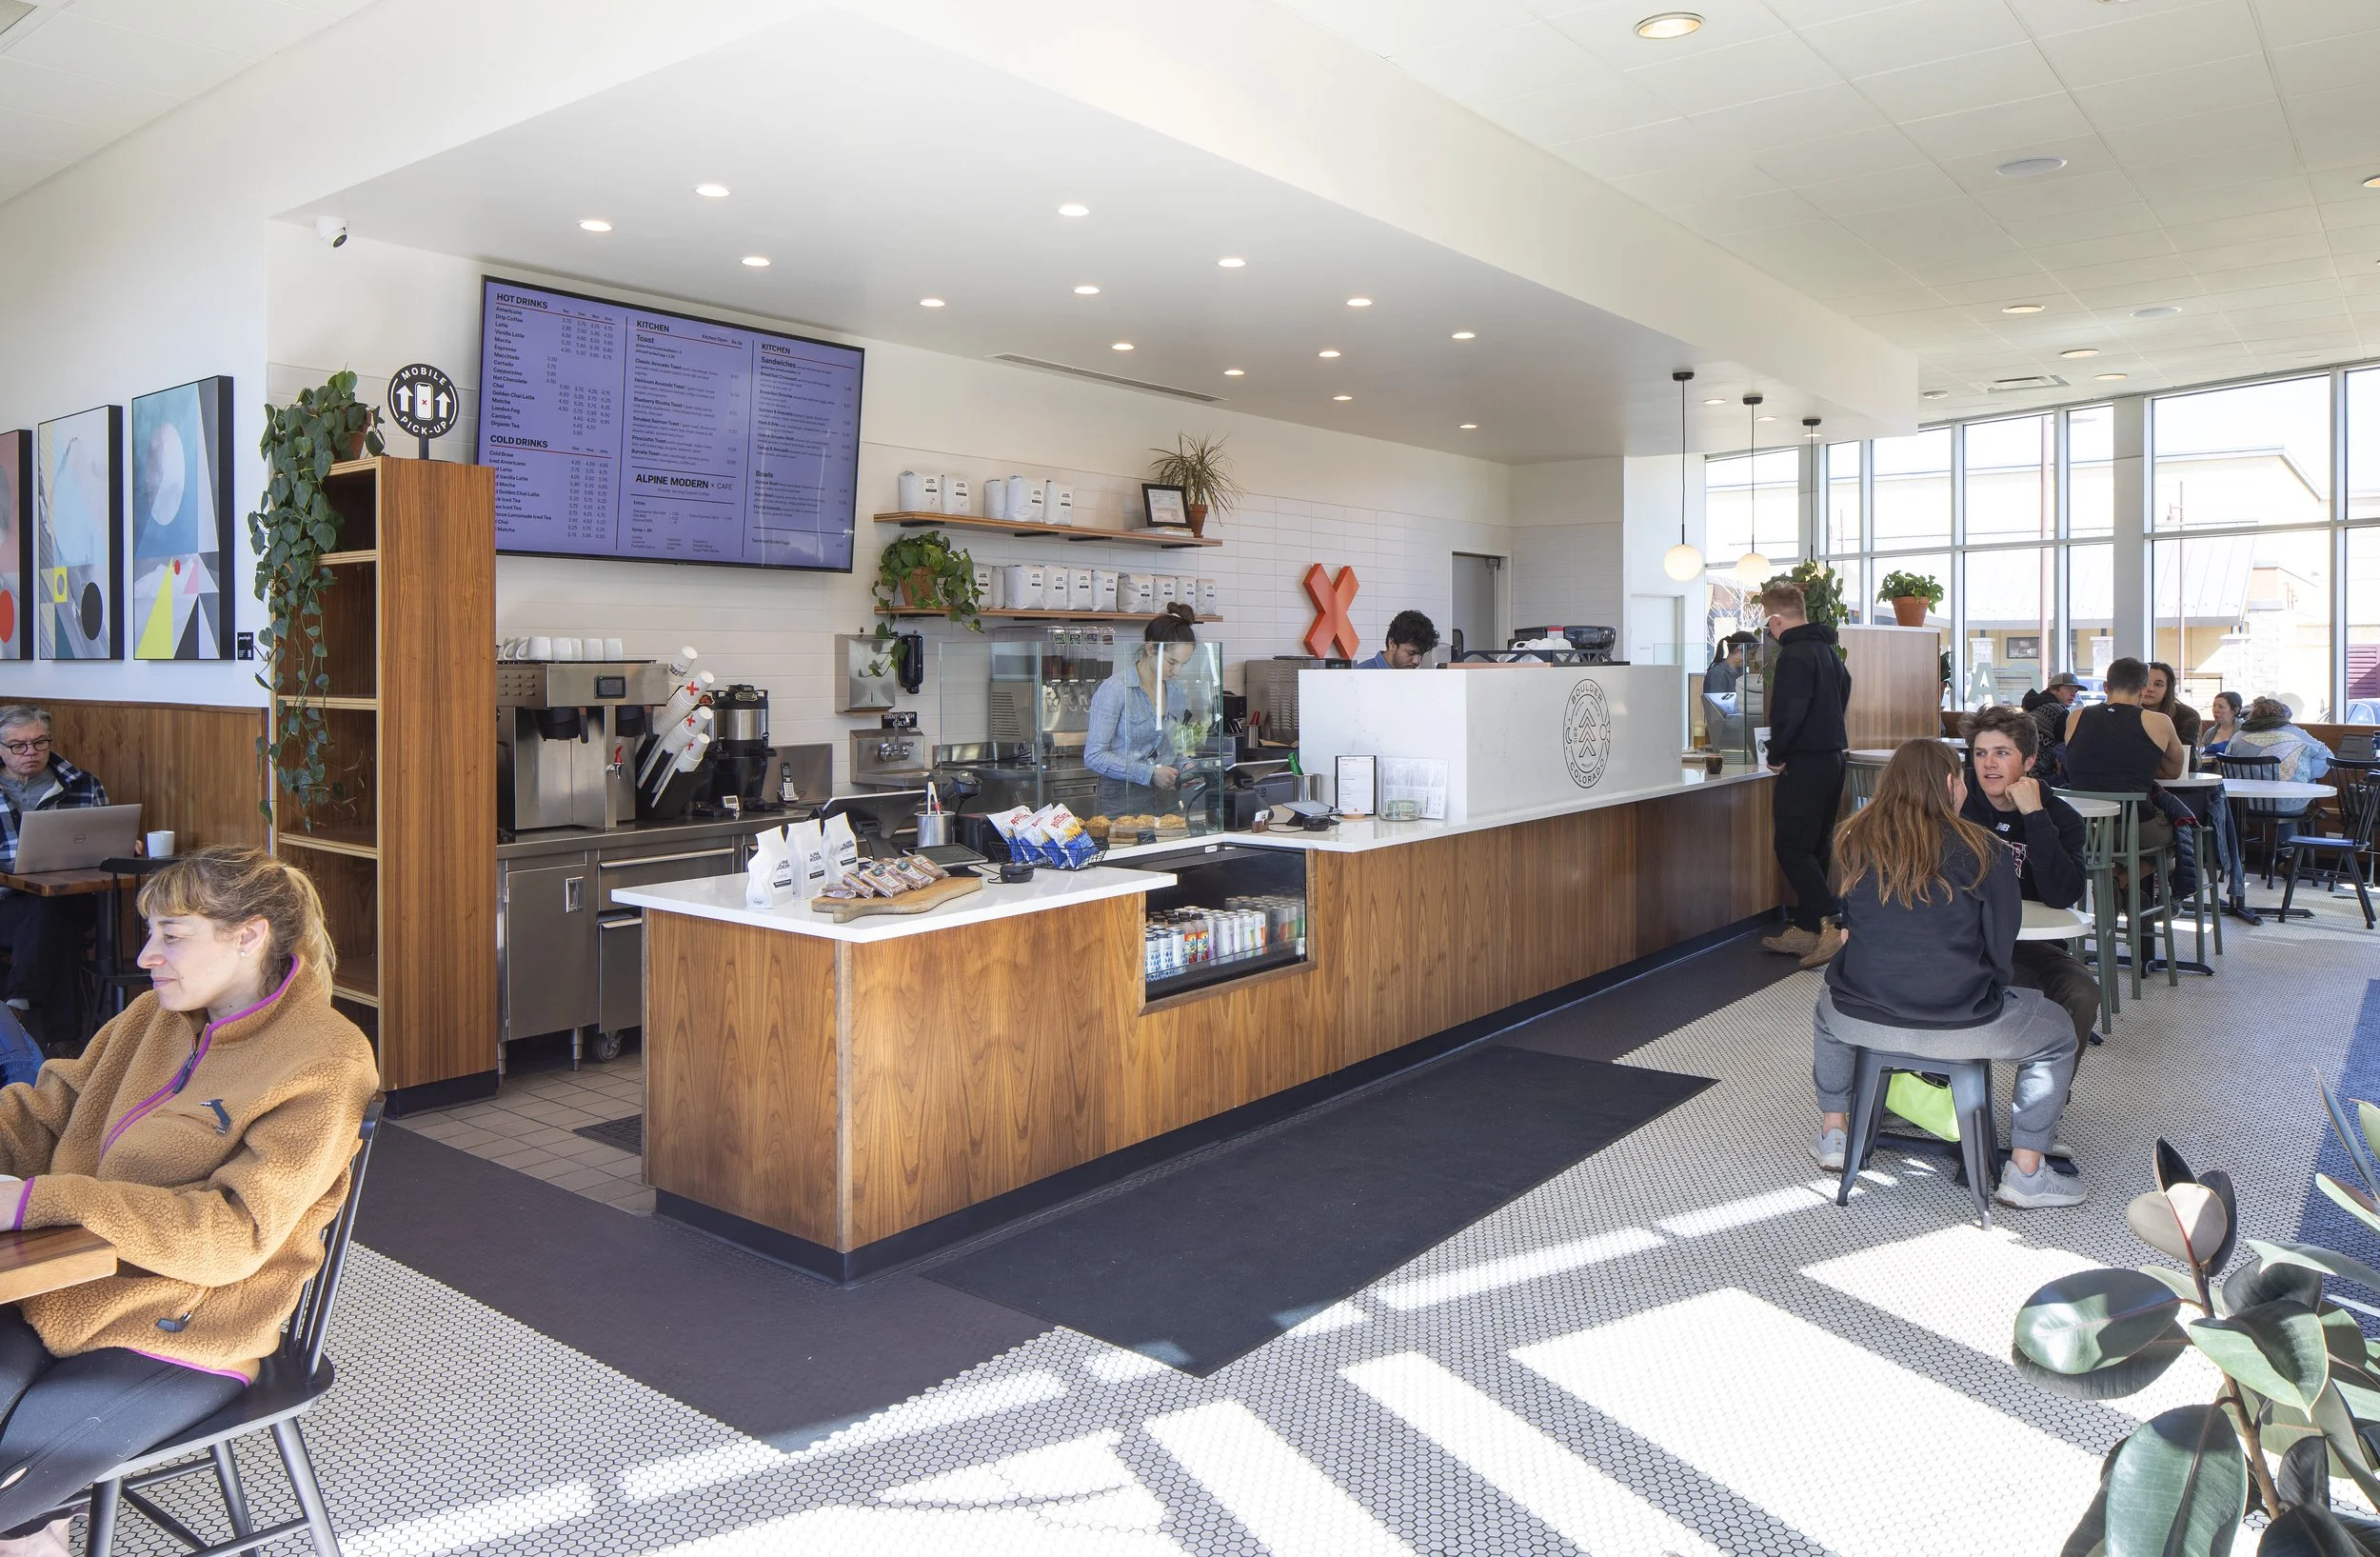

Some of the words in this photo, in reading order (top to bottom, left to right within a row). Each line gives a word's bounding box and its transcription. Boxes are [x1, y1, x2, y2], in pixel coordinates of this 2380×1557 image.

[497, 293, 514, 303] HOT
[516, 297, 548, 309] DRINKS
[496, 306, 522, 315] Americano
[637, 320, 670, 333] KITCHEN
[636, 335, 654, 344] Toast
[495, 345, 516, 353] Espresso
[762, 343, 790, 354] KITCHEN
[494, 352, 519, 360] Macchiato
[761, 357, 796, 368] Sandwiches
[401, 367, 447, 386] MOBILE
[494, 368, 522, 377] Cappuccino
[400, 416, 447, 435] PICK-UP
[490, 435, 514, 444] COLD
[516, 438, 548, 448] DRINKS
[636, 474, 668, 485] ALPINE
[671, 477, 708, 489] MODERN
[1571, 684, 1603, 705] BOULDER
[1570, 759, 1604, 784] COLORADO
